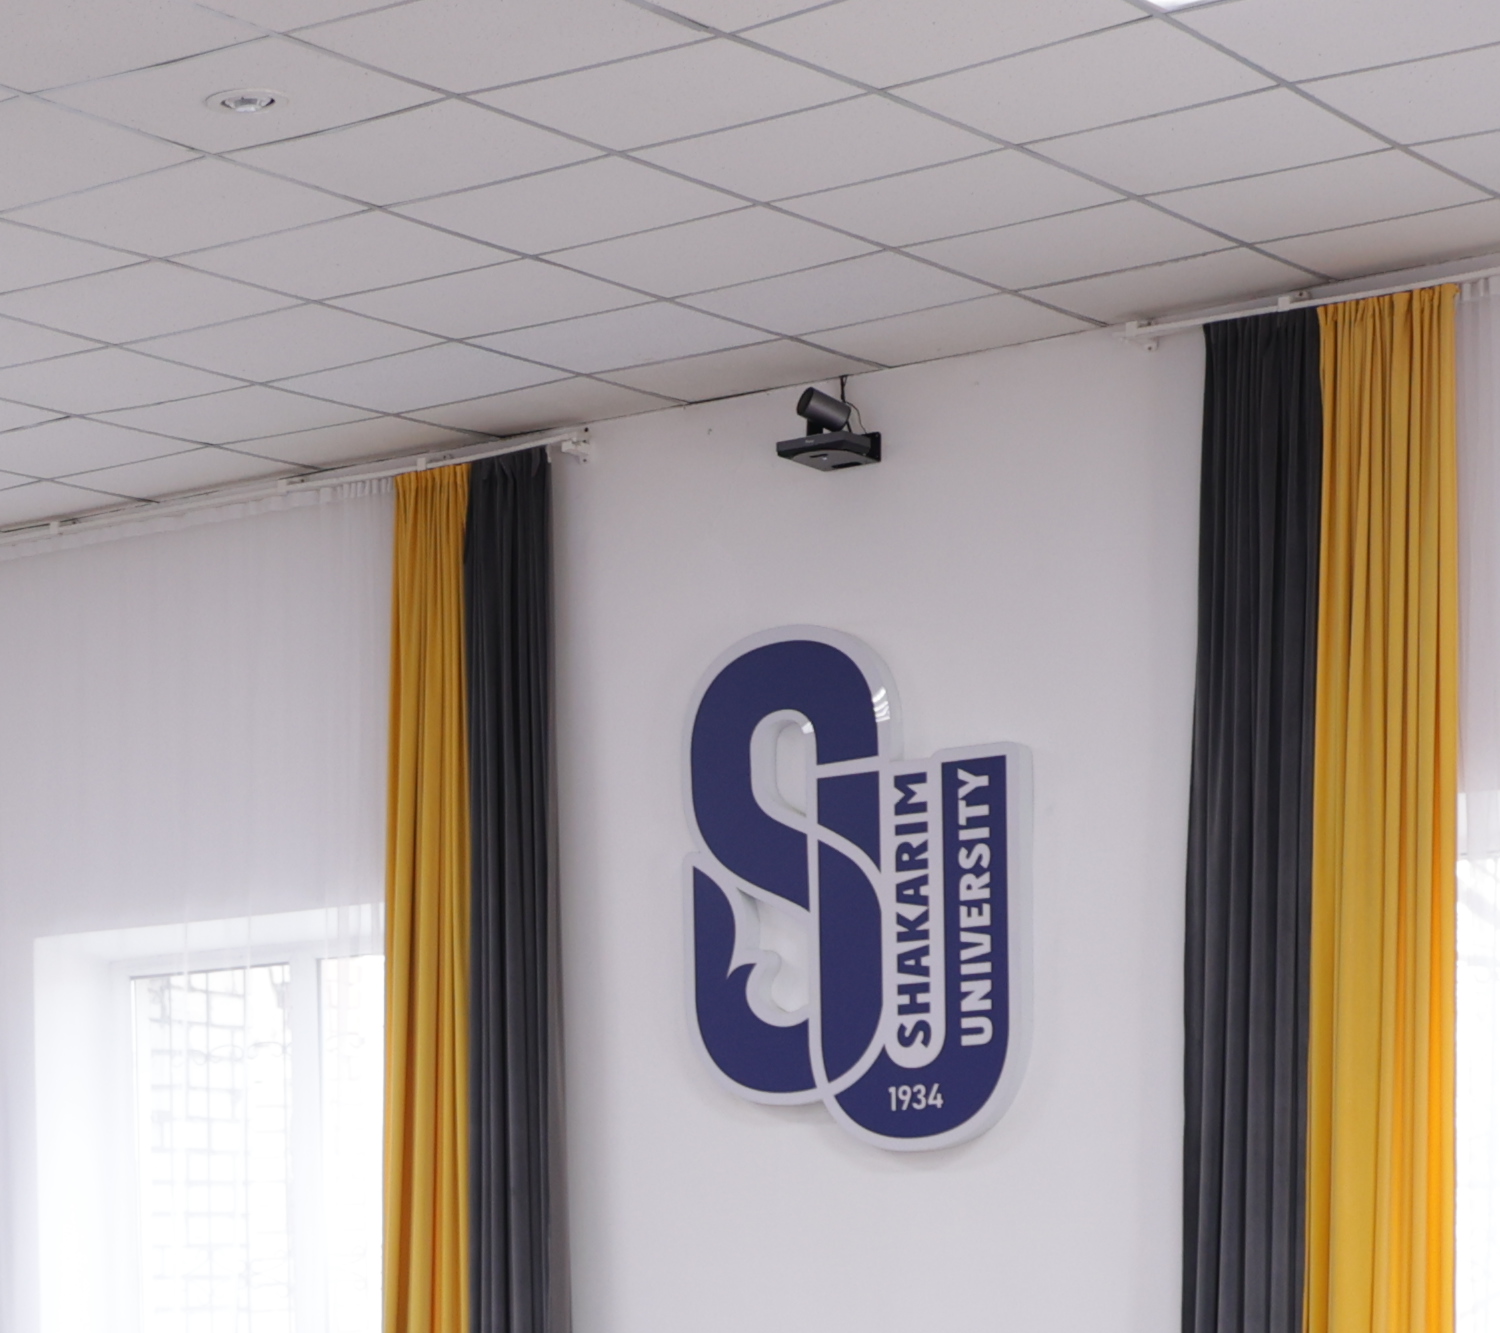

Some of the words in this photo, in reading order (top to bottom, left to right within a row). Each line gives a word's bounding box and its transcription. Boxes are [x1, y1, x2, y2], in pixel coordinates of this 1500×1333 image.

[893, 771, 932, 1049] SHAKARIM
[956, 767, 994, 1047] UNIVERSITY
[887, 1082, 944, 1112] 1934
